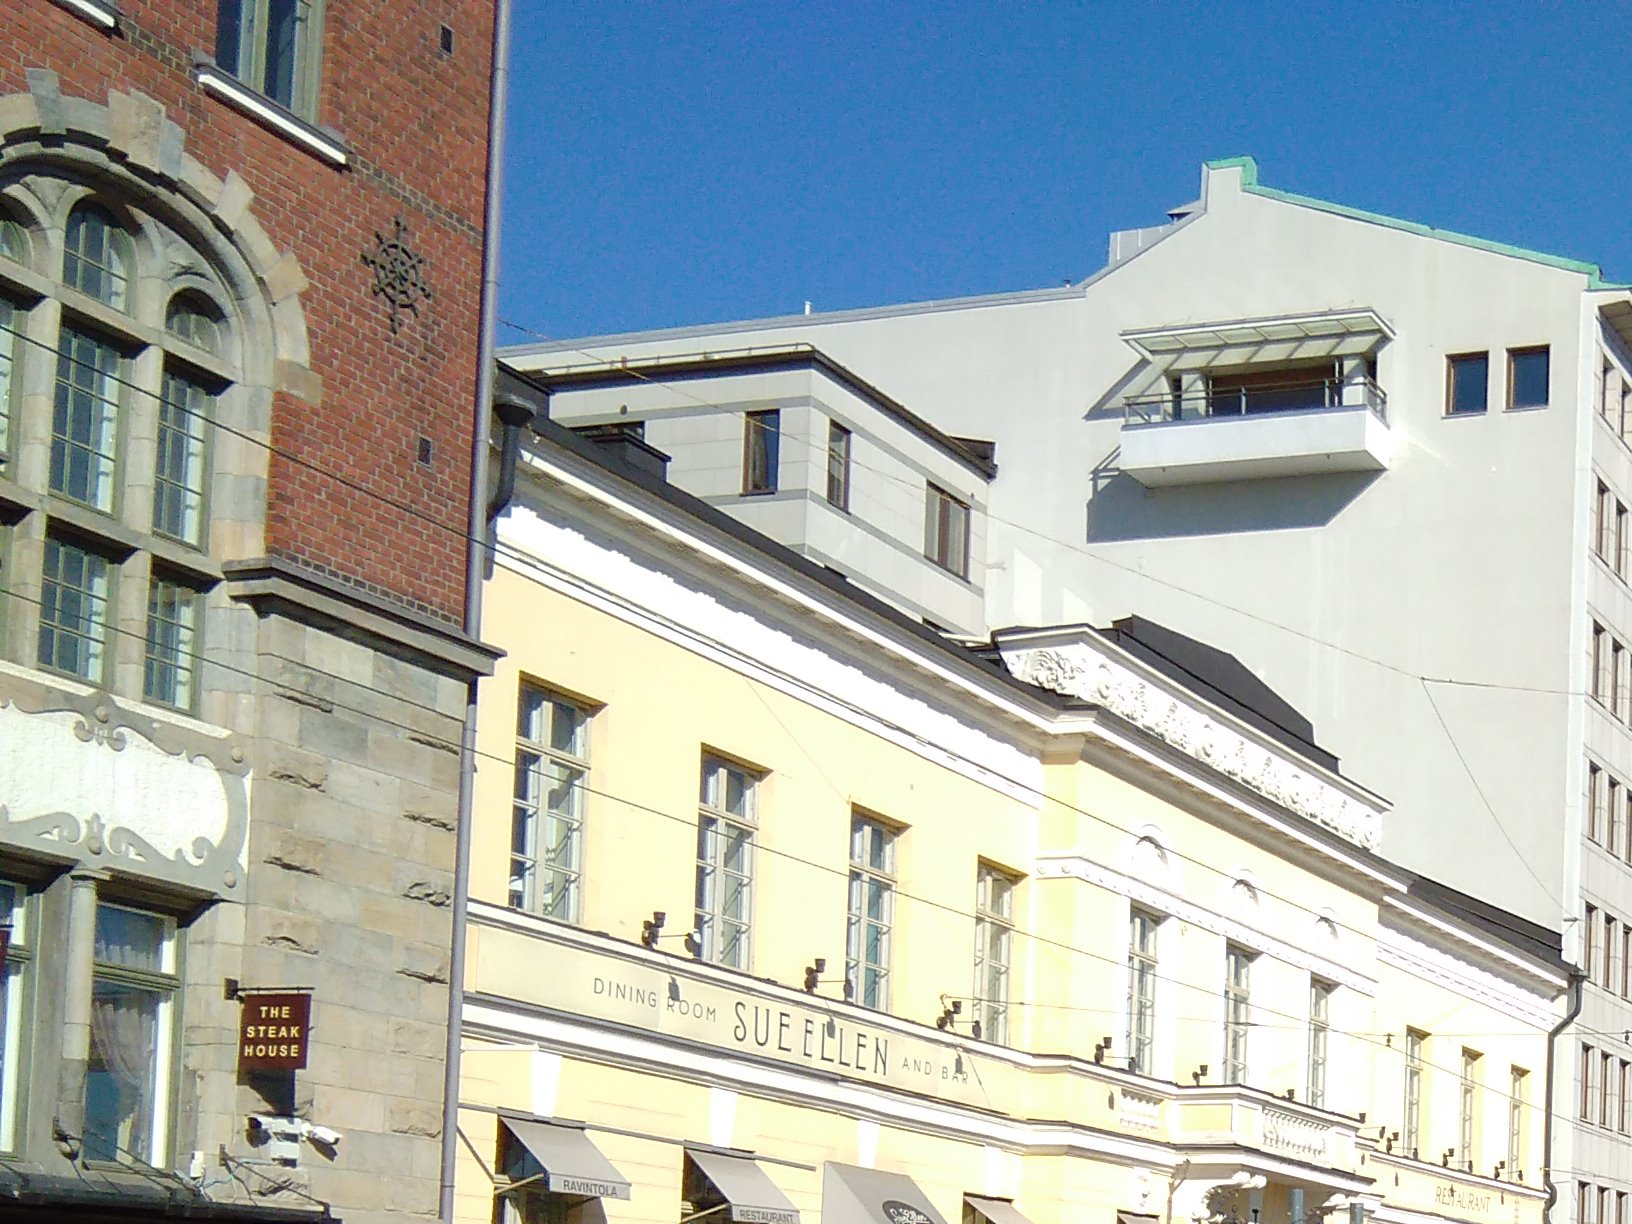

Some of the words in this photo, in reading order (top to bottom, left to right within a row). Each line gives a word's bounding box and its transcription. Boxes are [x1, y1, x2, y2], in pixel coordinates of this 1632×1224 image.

[260, 1006, 290, 1019] THE
[246, 1025, 300, 1038] STEAK
[593, 977, 657, 1008] DINING
[666, 995, 717, 1023] ROOM
[733, 1001, 792, 1052] SUE
[802, 1018, 888, 1076] ELLEN
[902, 1056, 932, 1076] AND
[941, 1065, 969, 1085] BAR
[244, 1044, 299, 1057] HOUSE
[563, 1179, 618, 1197] RAVINTOLA
[1434, 1185, 1491, 1213] RESTAURANT
[740, 1209, 794, 1224] RESTAURANT
